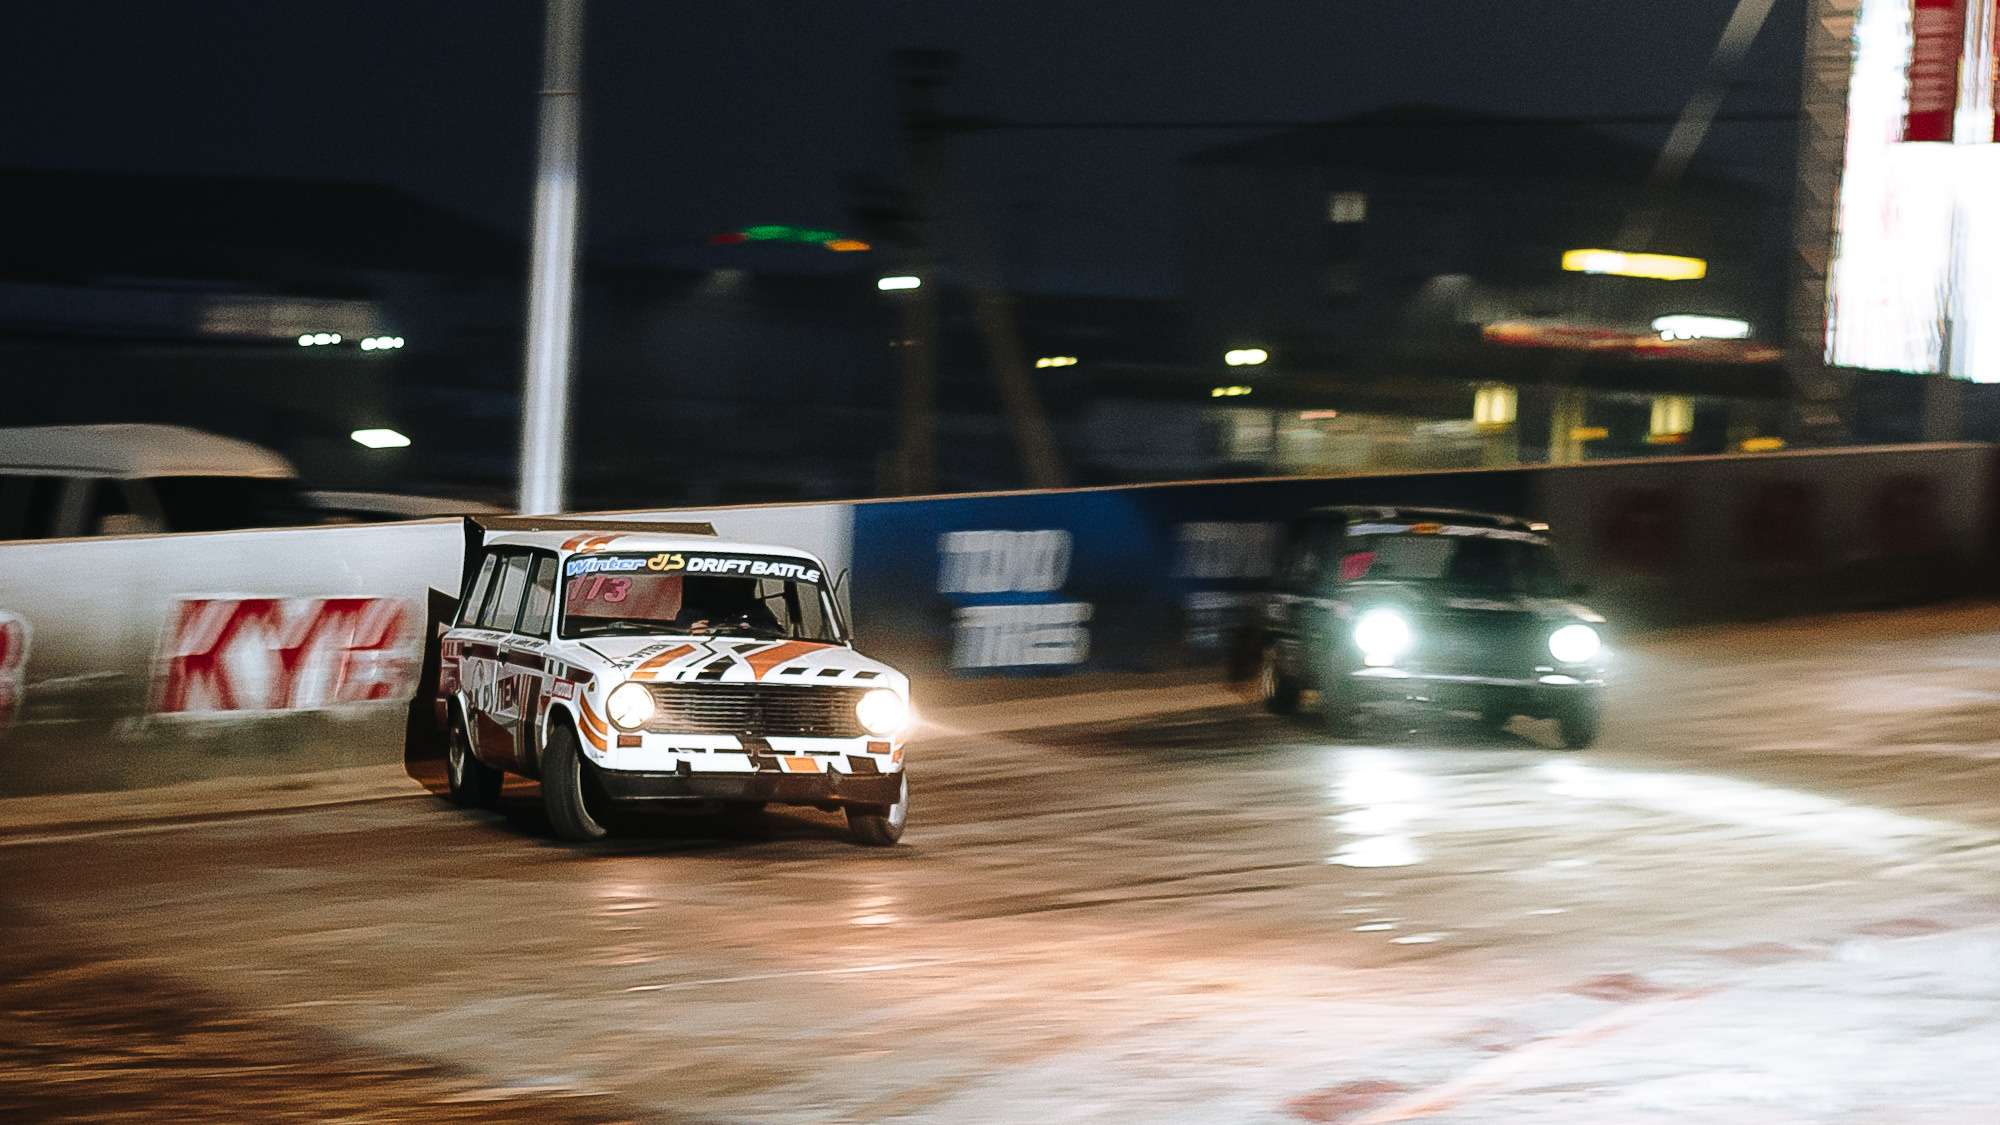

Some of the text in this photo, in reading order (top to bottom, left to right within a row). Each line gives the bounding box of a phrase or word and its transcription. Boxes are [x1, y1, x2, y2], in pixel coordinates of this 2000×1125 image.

[566, 557, 647, 577] Winter
[686, 557, 751, 574] DRIFT
[751, 561, 821, 583] BATTLE
